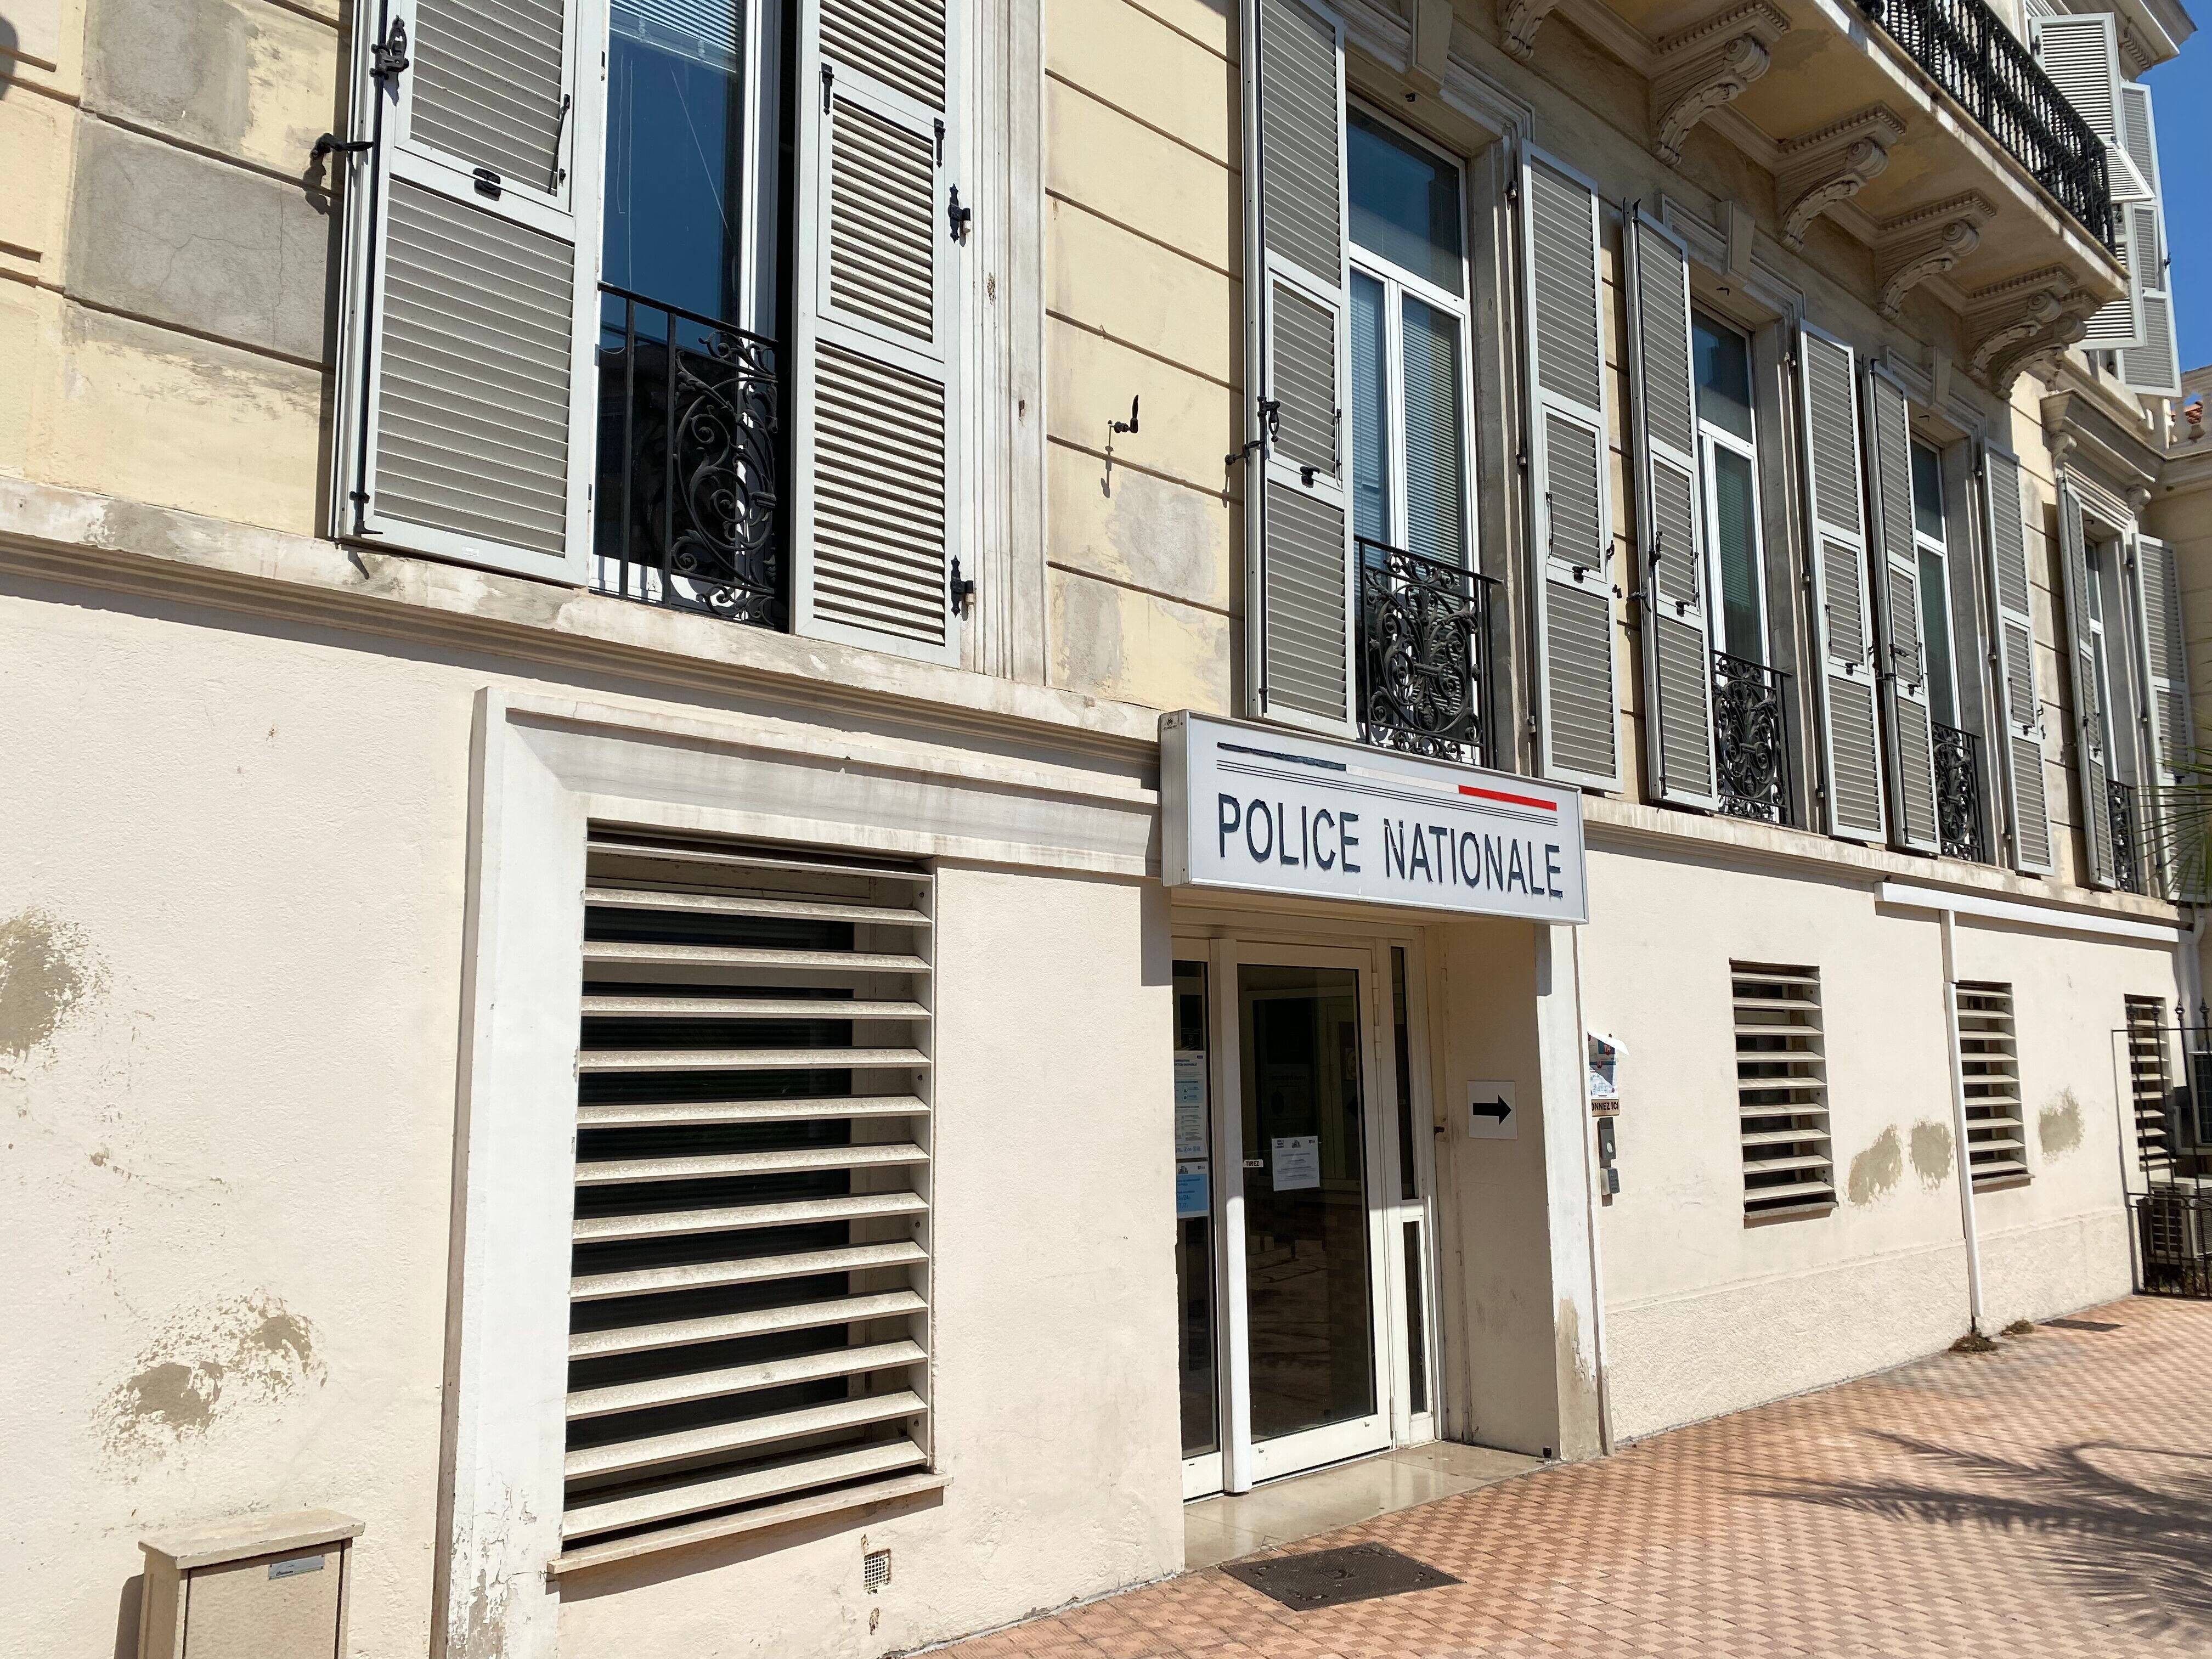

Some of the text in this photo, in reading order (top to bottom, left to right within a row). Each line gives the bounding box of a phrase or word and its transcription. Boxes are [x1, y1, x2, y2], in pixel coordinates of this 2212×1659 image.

[1217, 792, 1564, 899] POLICE NATIONALE
[1592, 1102, 1619, 1111] ONNEZ ICI
